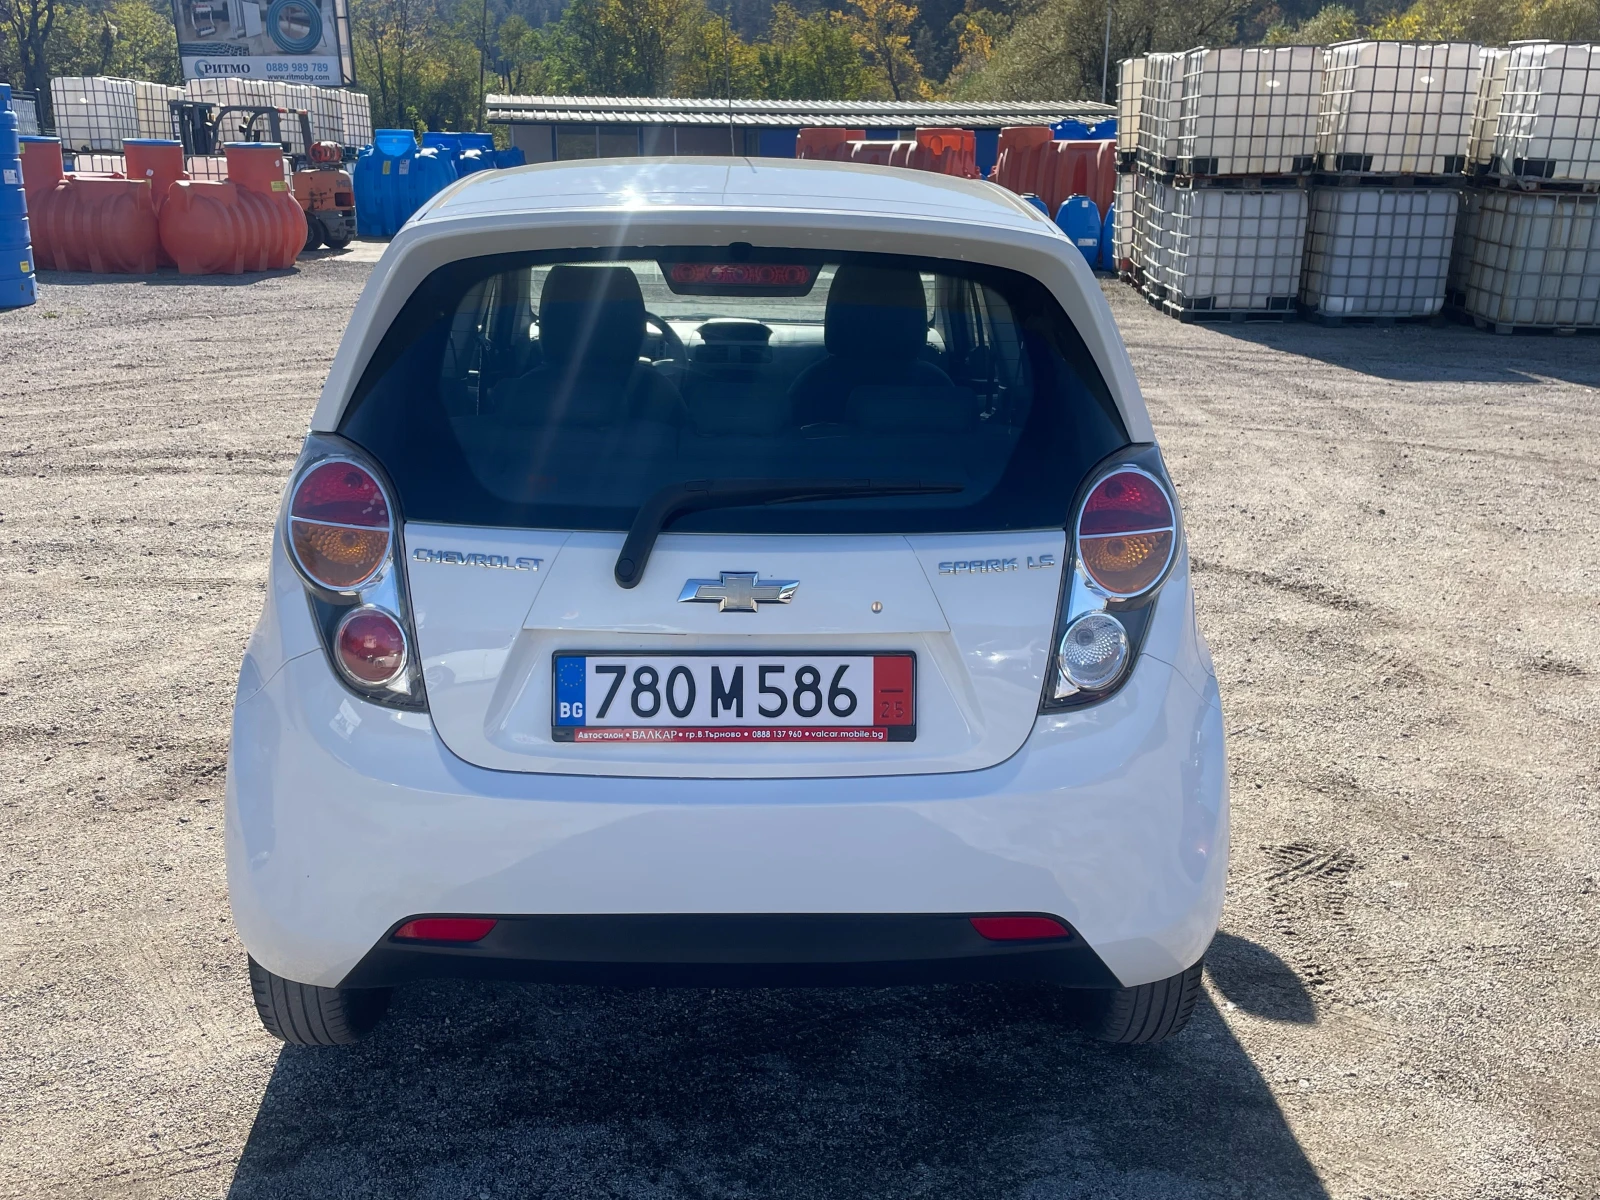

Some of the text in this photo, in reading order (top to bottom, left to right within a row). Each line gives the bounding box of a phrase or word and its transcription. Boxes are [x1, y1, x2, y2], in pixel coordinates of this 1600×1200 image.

[204, 63, 251, 74] РИТМО
[266, 62, 329, 73] 0889 989 789
[267, 73, 330, 82] www.ritmobg.com
[412, 548, 544, 571] CHEVROLET
[938, 554, 1055, 575] SPARK LS
[594, 665, 858, 719] 780 M 586
[559, 702, 584, 718] BG
[880, 701, 905, 718] 25
[577, 730, 624, 740] Автосалон
[631, 730, 678, 740] ВАЛКАР
[752, 729, 771, 739] 0888
[773, 729, 786, 739] 137
[788, 729, 802, 739] 960
[811, 729, 884, 742] valcar.mobile.bg
